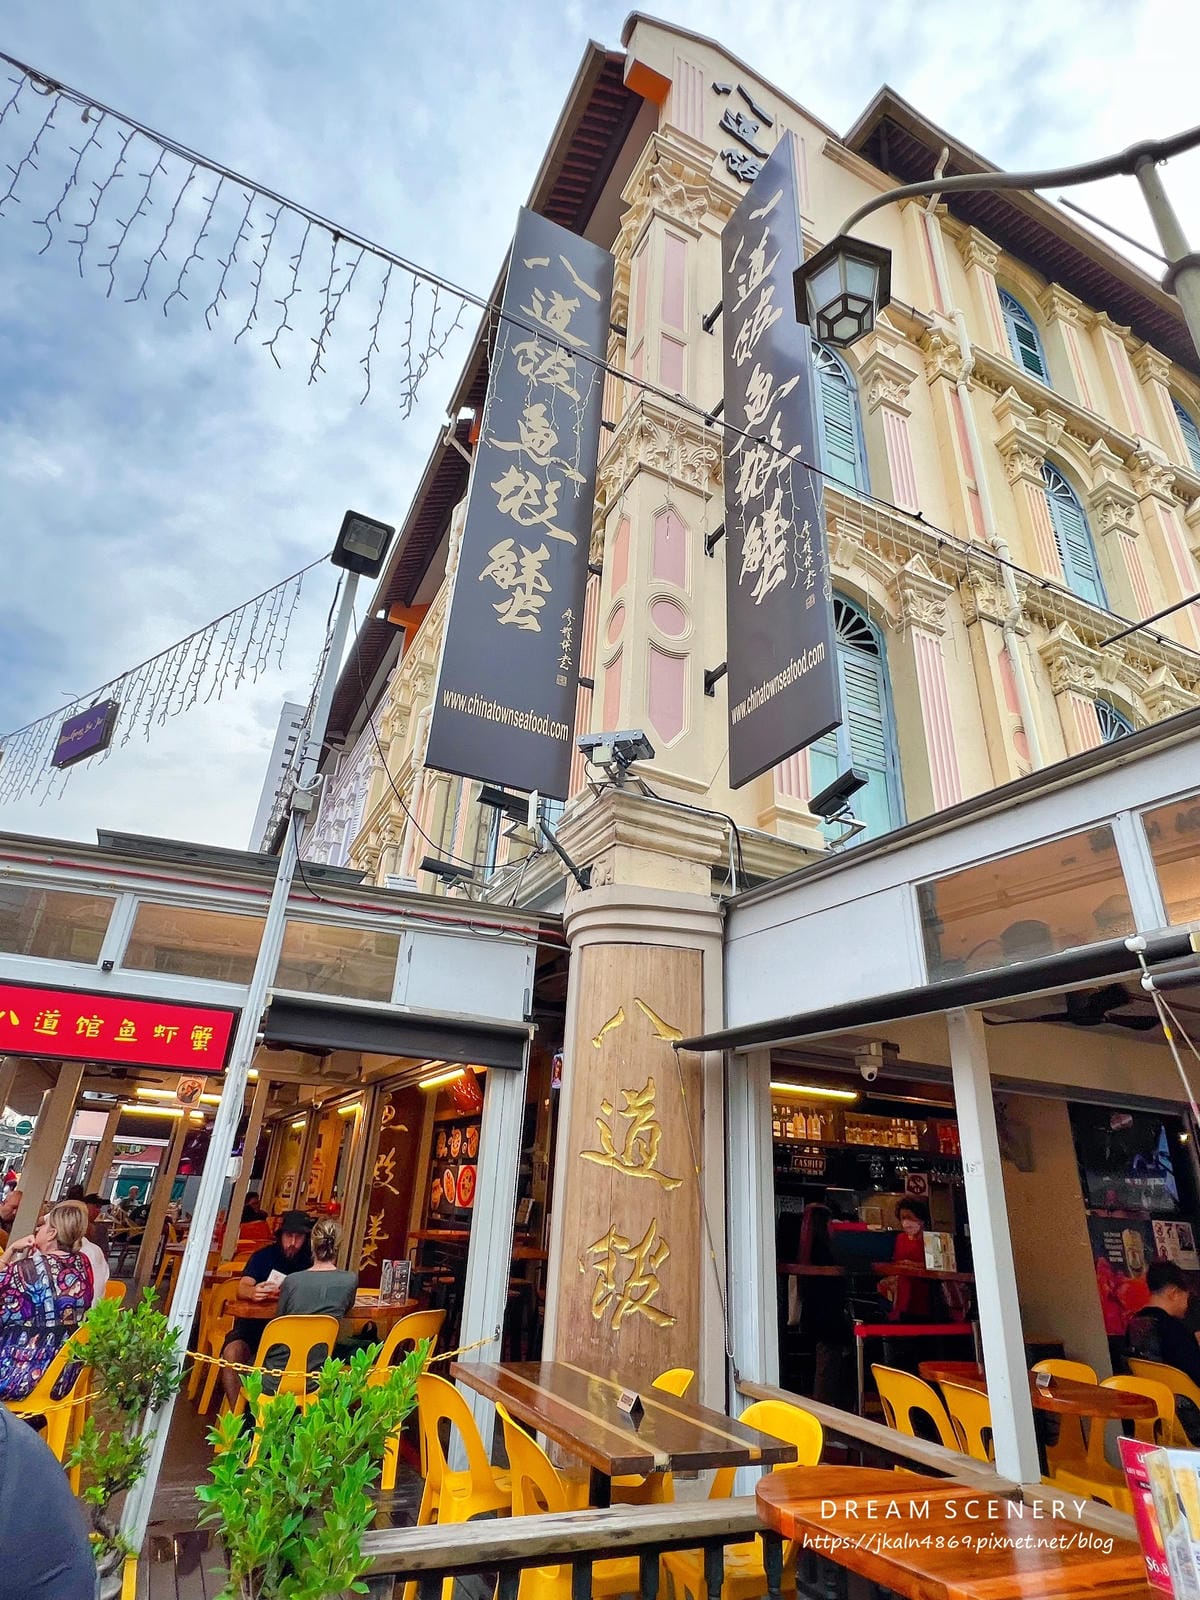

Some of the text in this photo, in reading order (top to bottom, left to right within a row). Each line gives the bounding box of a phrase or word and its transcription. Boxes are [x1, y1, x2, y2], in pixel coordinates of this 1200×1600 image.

[731, 641, 825, 726] www.chinatownseafood.com
[443, 689, 569, 741] www.chinatownseafood.com
[0, 1009, 213, 1051] 八道馆鱼虾蟹
[794, 1158, 824, 1169] CASHIER
